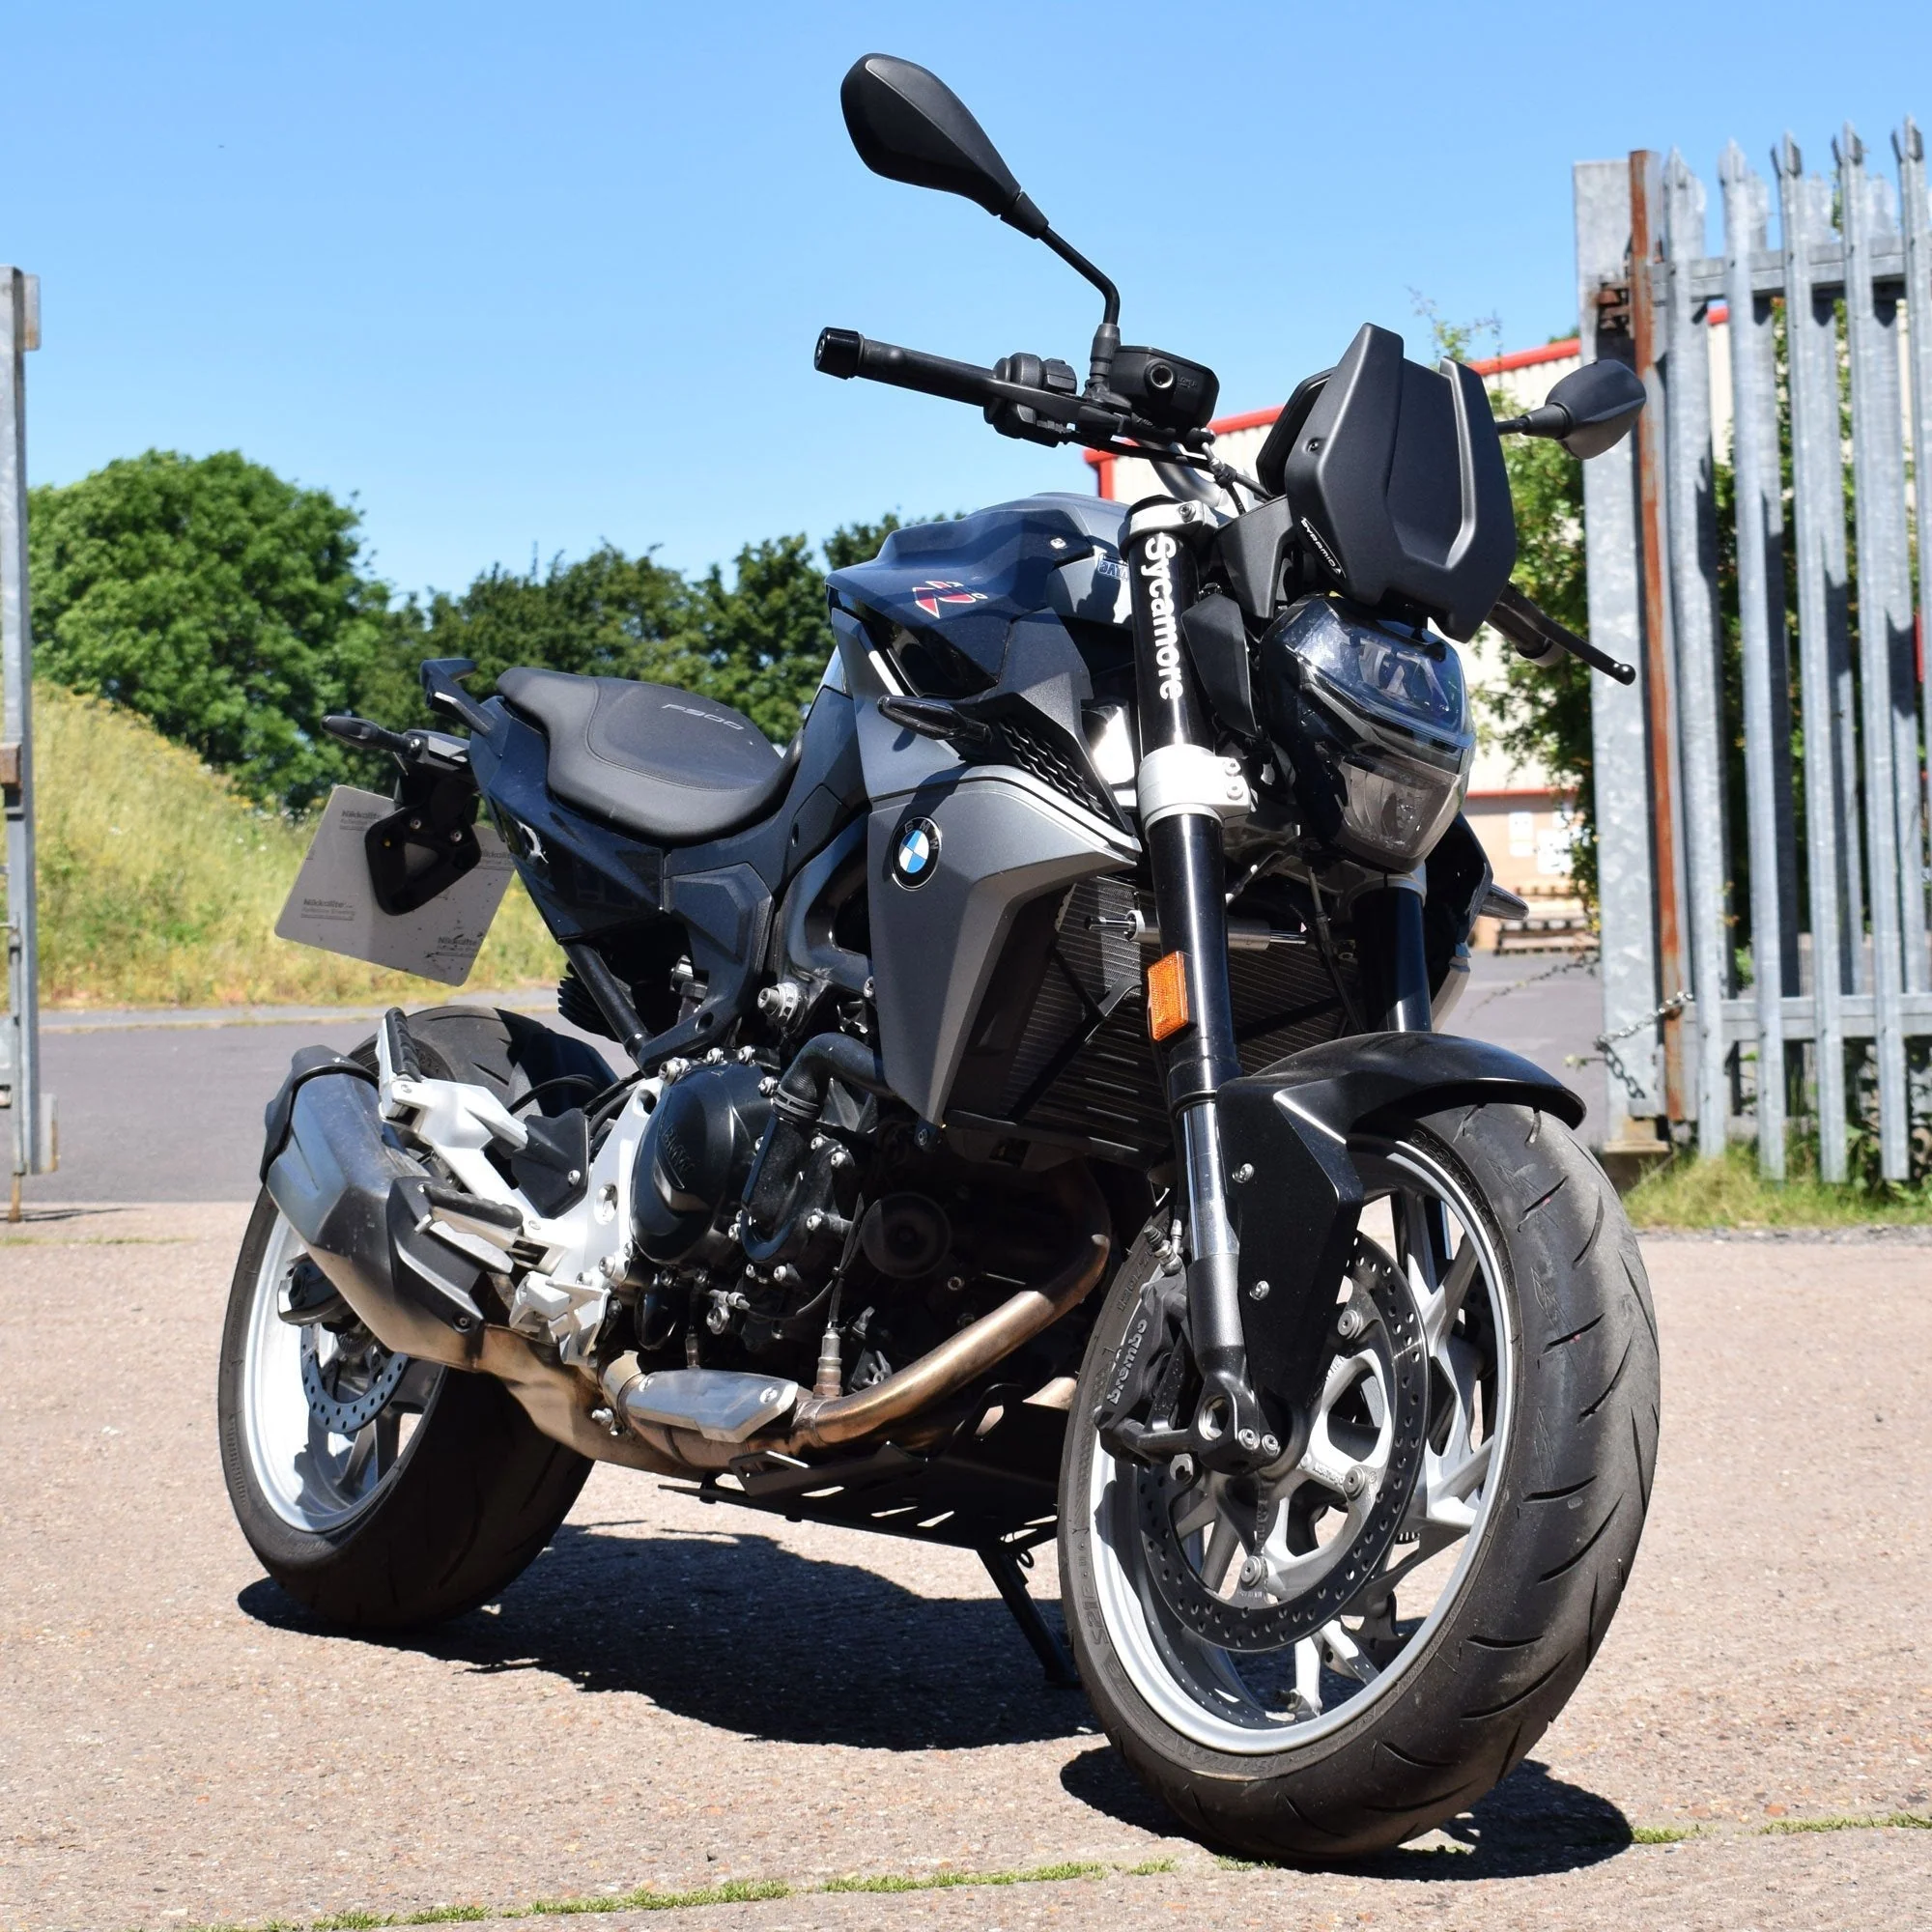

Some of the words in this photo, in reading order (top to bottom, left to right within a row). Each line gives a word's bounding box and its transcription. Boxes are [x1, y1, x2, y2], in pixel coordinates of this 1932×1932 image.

[1140, 531, 1184, 701] Sycamore
[661, 703, 745, 730] F900
[903, 819, 940, 851] BMW
[1106, 1318, 1149, 1406] brembo
